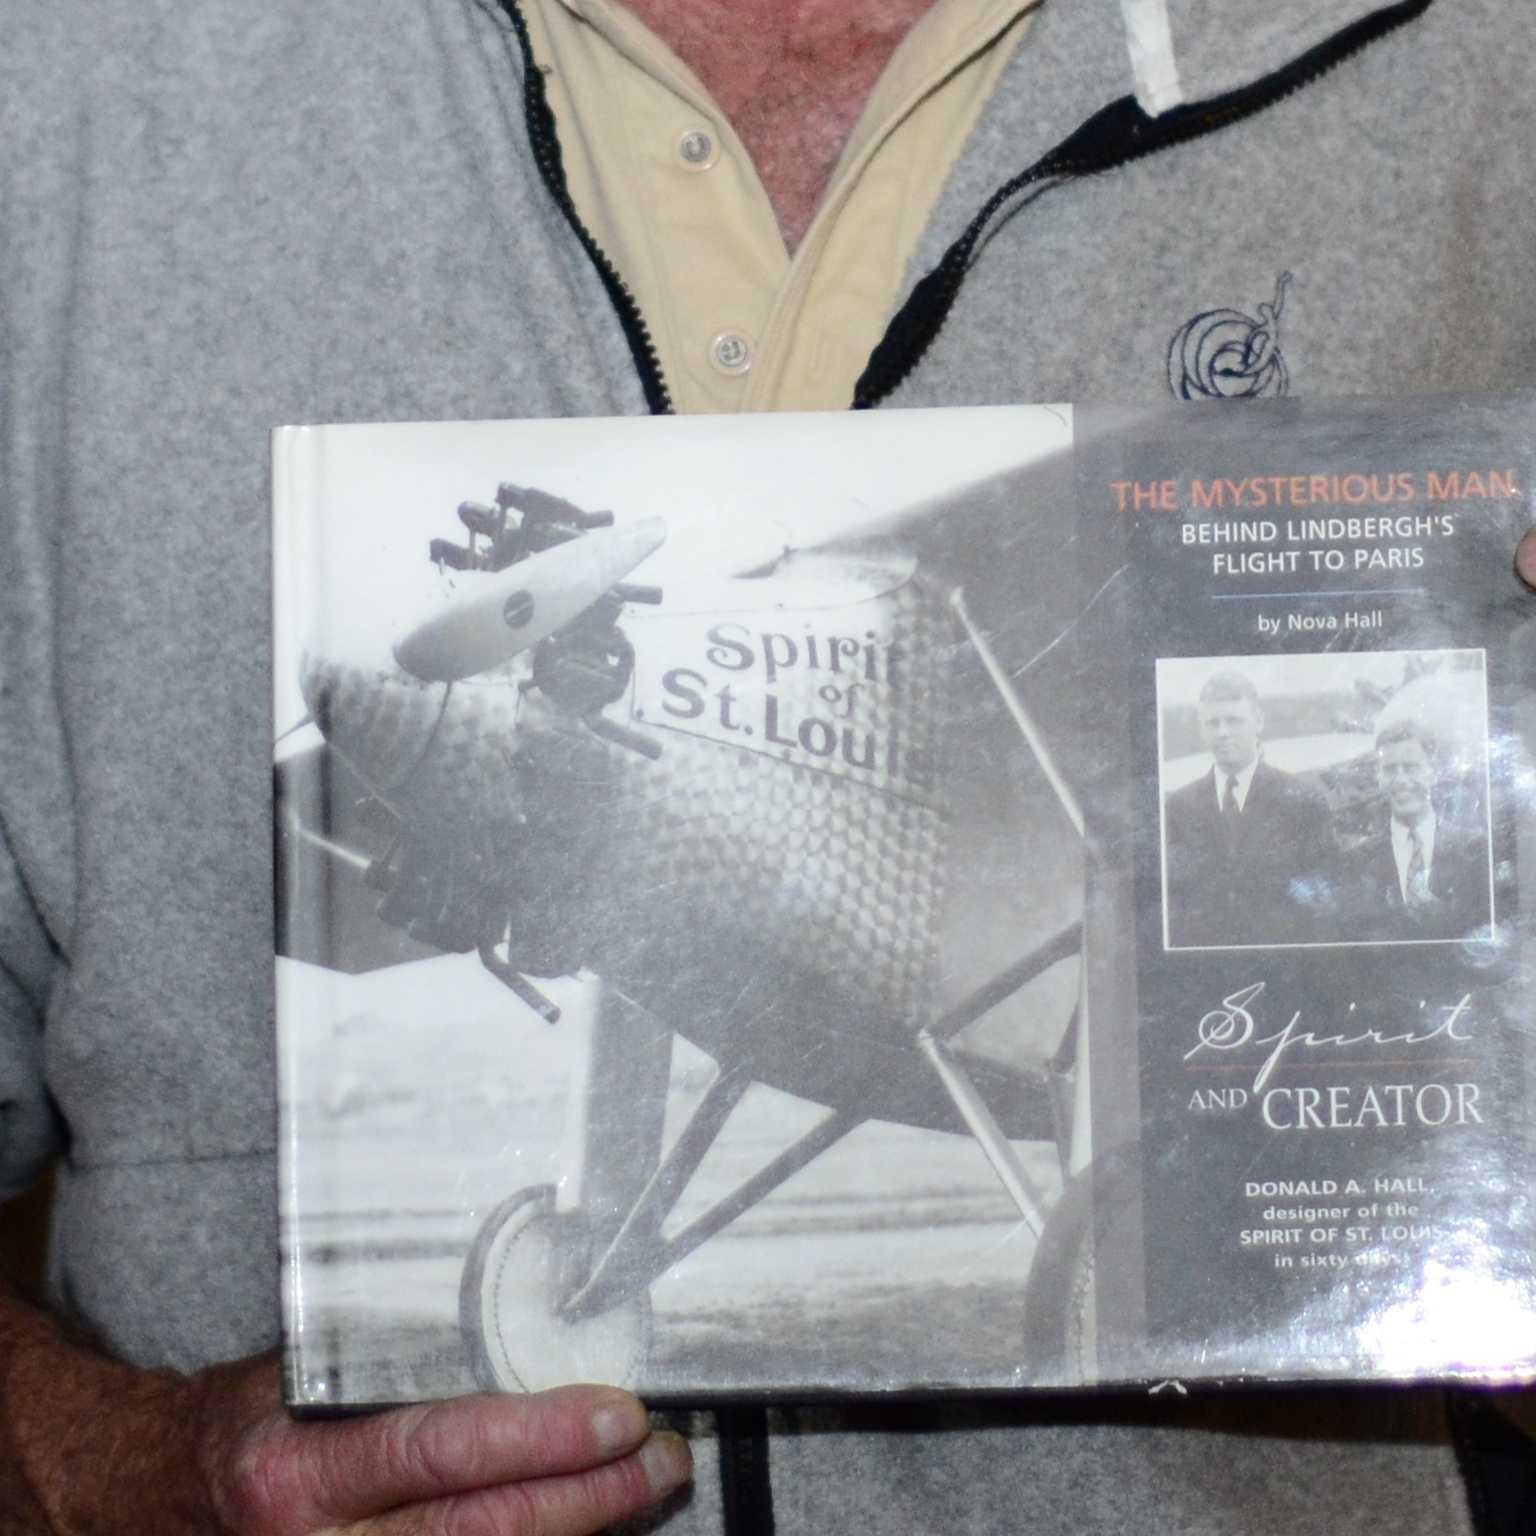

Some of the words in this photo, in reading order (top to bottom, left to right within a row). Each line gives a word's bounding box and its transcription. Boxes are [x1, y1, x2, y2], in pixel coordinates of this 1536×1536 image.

[1111, 480, 1177, 512] THE
[1191, 472, 1415, 509] MYSTERIOUS
[1181, 522, 1277, 545] BEHIND
[1287, 516, 1454, 542] LINDBERGH'S
[1213, 551, 1300, 574] FLIGHT
[1309, 550, 1344, 571] TO
[1354, 547, 1424, 569] PARIS
[1257, 613, 1281, 633] by
[1287, 613, 1338, 631] Nova
[1345, 611, 1383, 629] Hall
[818, 683, 864, 719] of
[1183, 981, 1473, 1093] Spirit
[1187, 1088, 1248, 1111] AND
[1262, 1083, 1485, 1131] CREATOR
[1245, 1180, 1337, 1198] DONALD
[1345, 1179, 1366, 1195] A.
[1264, 1205, 1351, 1223] designer
[1358, 1203, 1378, 1218] of
[1385, 1202, 1419, 1217] the
[1240, 1228, 1303, 1245] SPIRIT
[1310, 1227, 1338, 1244] OF
[1345, 1226, 1373, 1243] ST.
[1274, 1253, 1293, 1268] in
[1301, 1252, 1348, 1270] sixty
